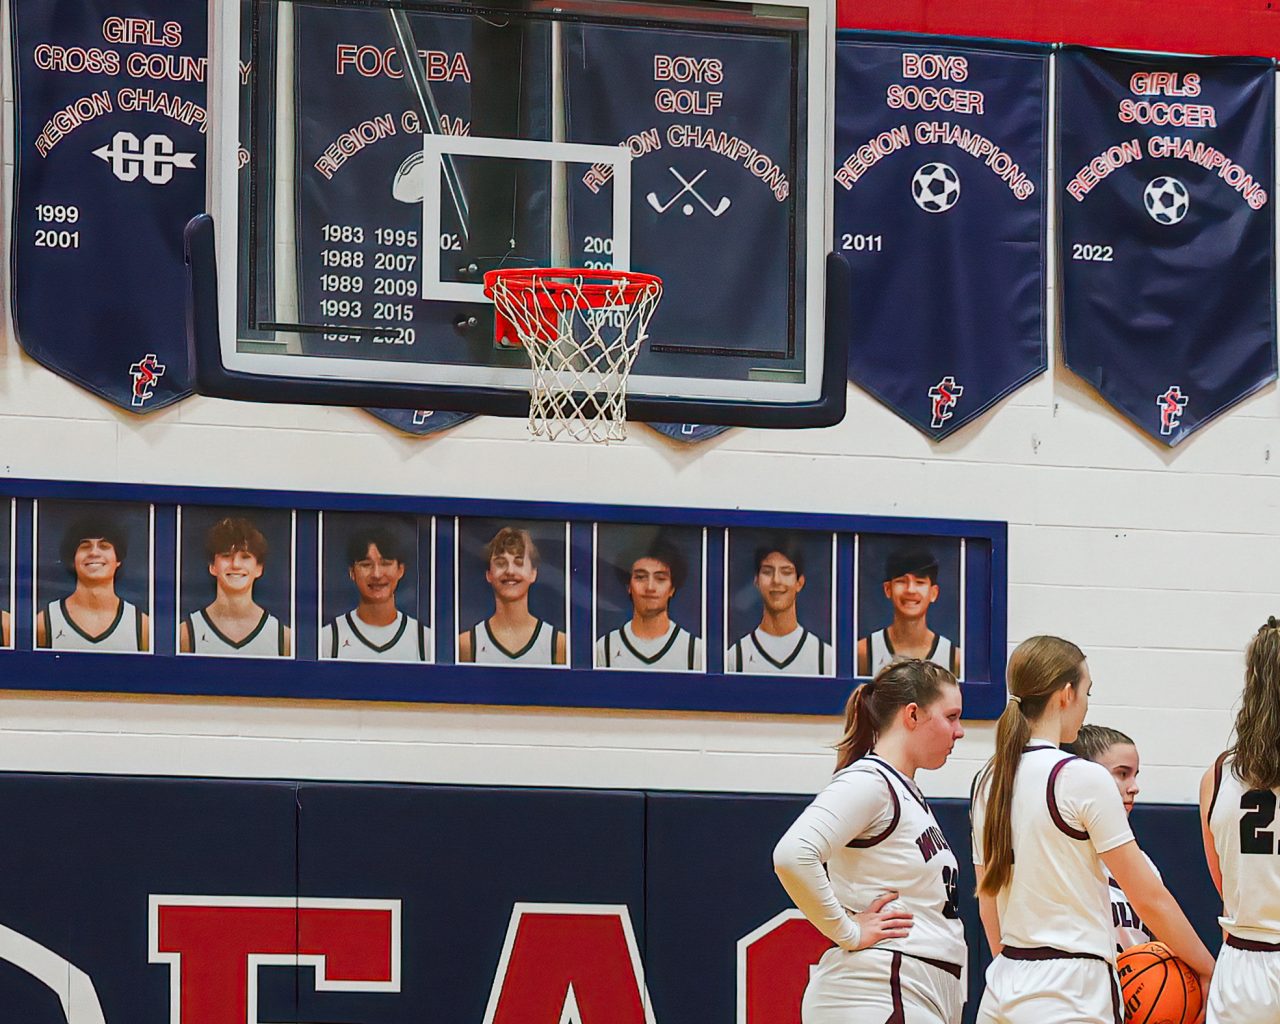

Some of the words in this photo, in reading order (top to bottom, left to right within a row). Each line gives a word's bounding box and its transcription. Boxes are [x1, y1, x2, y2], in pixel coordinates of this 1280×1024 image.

[103, 17, 182, 47] GIRLS
[34, 44, 120, 75] CROSS
[654, 55, 723, 84] BOYS
[903, 53, 968, 82] BOYS
[1130, 72, 1201, 97] GIRLS
[655, 88, 722, 115] GOLF
[887, 85, 984, 114] SOCCER
[1118, 99, 1216, 127] SOCCER
[34, 91, 113, 158] REGION
[315, 114, 396, 181] REGION
[834, 124, 910, 190] REGION
[915, 122, 1035, 201] CHAMPIONS
[668, 124, 790, 203] CHAMPIONS
[1066, 138, 1142, 202] REGION
[1148, 136, 1268, 210] CHAMPIONS
[36, 205, 78, 223] 1999
[35, 230, 78, 248] 2001
[322, 225, 364, 243] 1983
[375, 228, 417, 247] 1995
[842, 234, 881, 251] 2011
[321, 250, 363, 268] 1988
[375, 253, 416, 271] 2007
[1073, 244, 1113, 261] 2022
[320, 274, 363, 292] 1989
[374, 278, 417, 296] 2009
[320, 299, 361, 317] 1993
[374, 303, 413, 321] 2015
